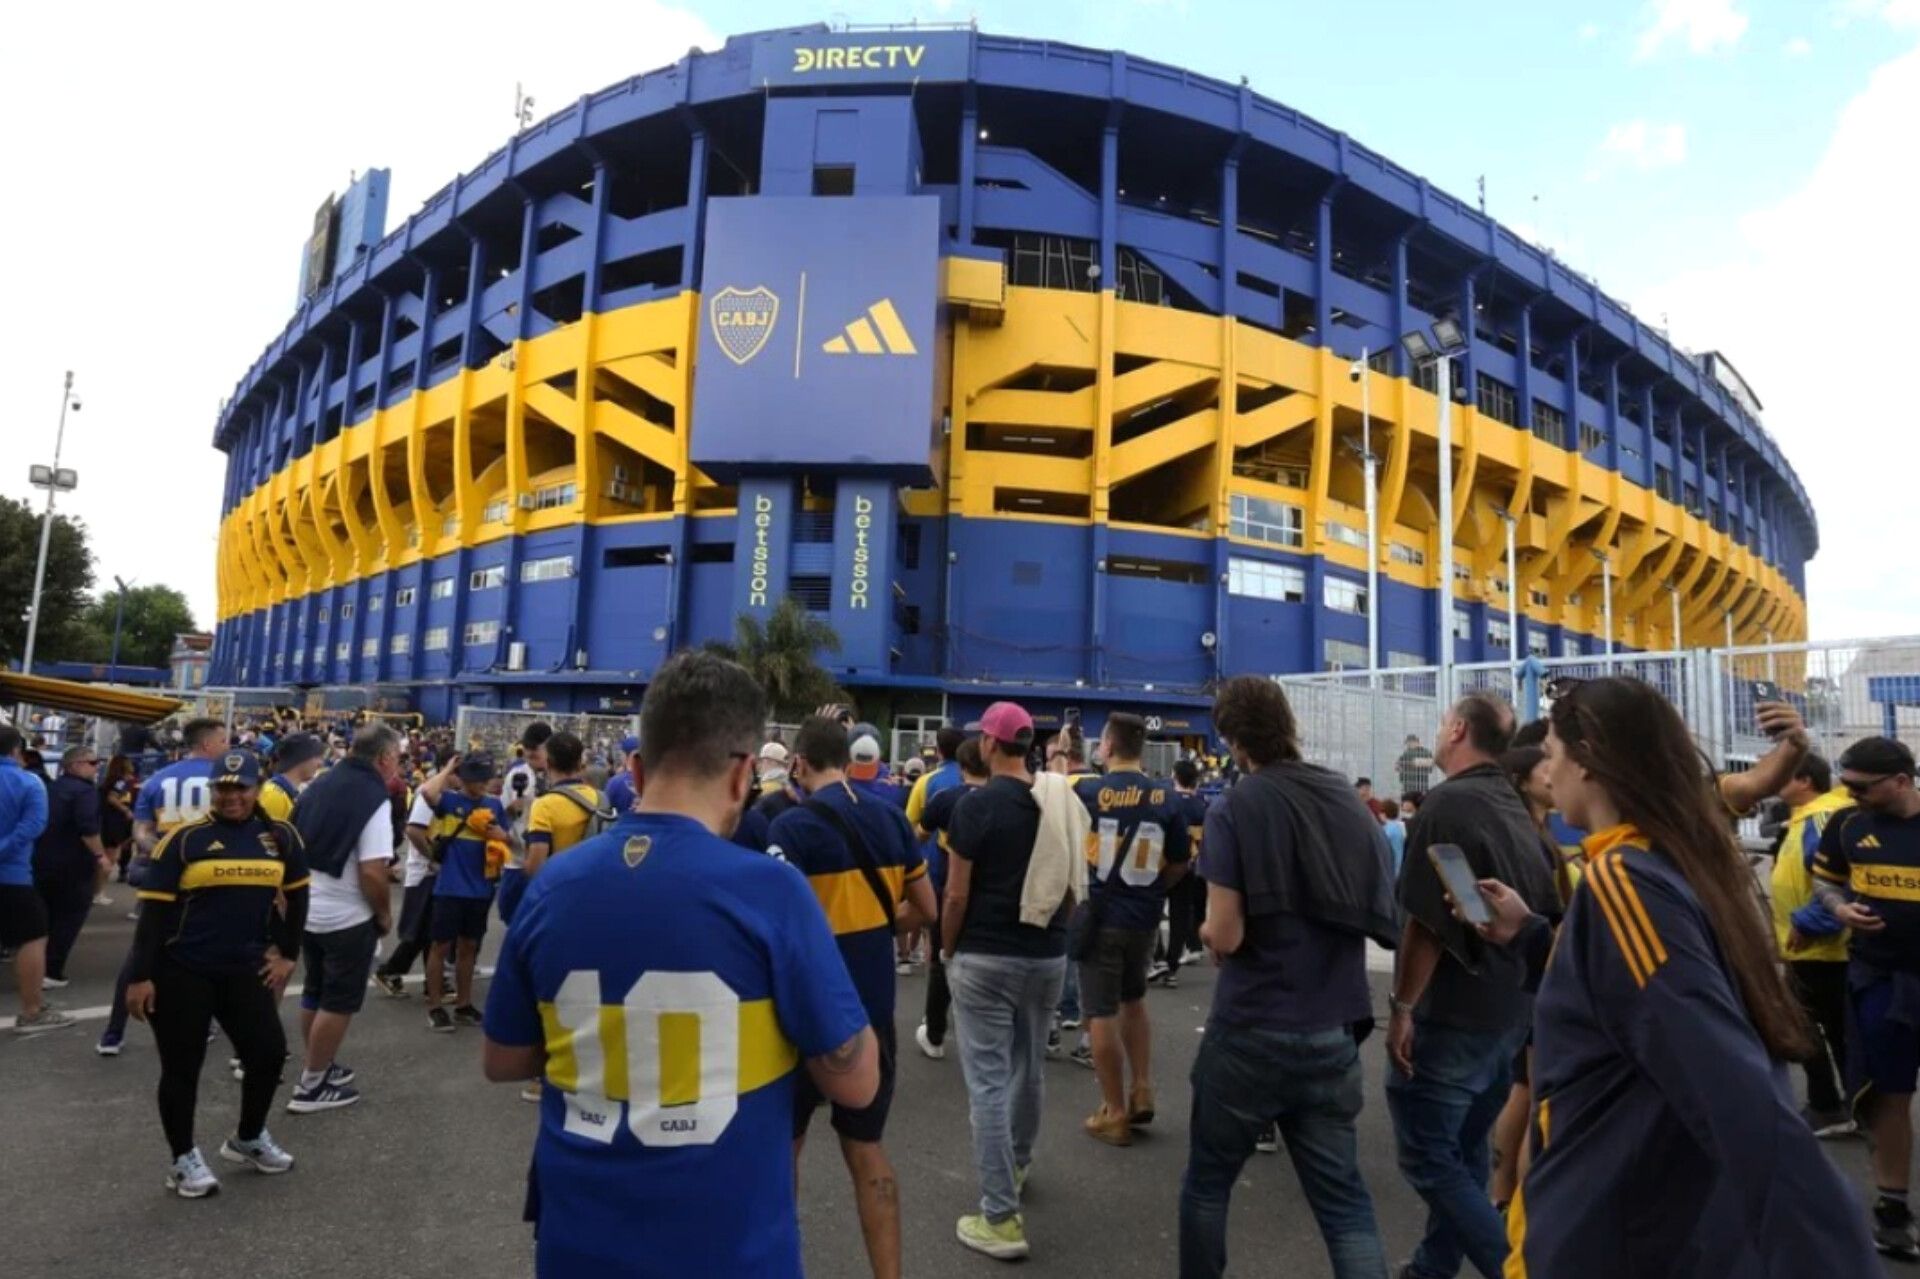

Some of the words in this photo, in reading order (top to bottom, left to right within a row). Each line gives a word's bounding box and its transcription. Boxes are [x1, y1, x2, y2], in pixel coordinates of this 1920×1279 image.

[792, 45, 925, 72] DIRECTV
[719, 311, 769, 326] CABJ
[750, 494, 772, 606] betsson
[850, 495, 872, 608] betsson
[161, 776, 211, 822] 10
[553, 969, 740, 1147] 10
[660, 1119, 698, 1132] CABJ
